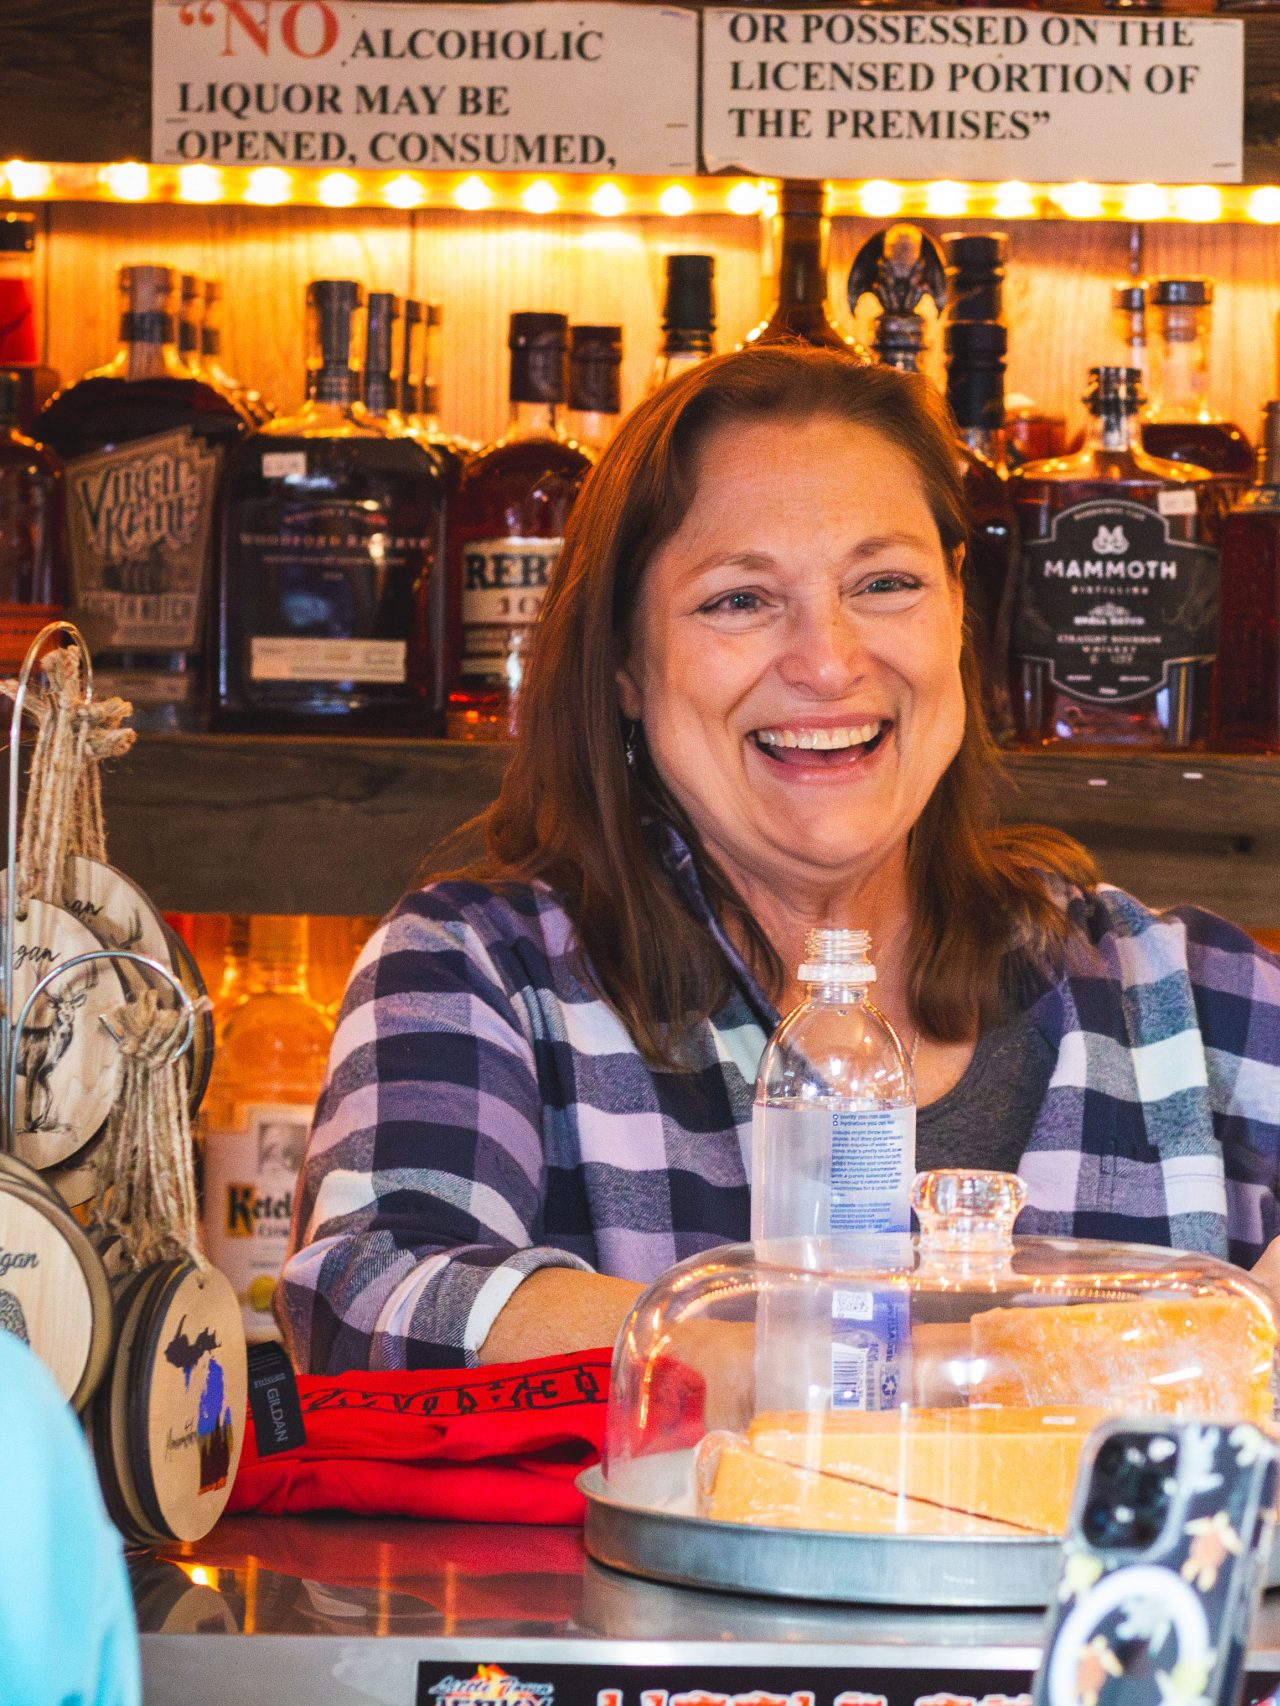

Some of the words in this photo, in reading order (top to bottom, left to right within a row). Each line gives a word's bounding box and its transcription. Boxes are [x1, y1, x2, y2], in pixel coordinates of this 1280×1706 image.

[350, 28, 603, 61] ALCOHOLIC
[728, 13, 788, 46] OR
[803, 14, 1028, 47] POSSESSED
[1042, 16, 1098, 46] ON
[1114, 20, 1195, 47] THE
[728, 61, 934, 92] LICENSED
[949, 63, 1131, 94] PORTION
[1145, 64, 1200, 95] OF
[178, 83, 342, 119] LIQUOR
[355, 85, 448, 117] MAY
[458, 86, 511, 117] BE
[728, 108, 811, 139] THE
[176, 131, 357, 166] OPENED,
[369, 132, 618, 170] CONSUMED,
[465, 553, 558, 591] REB
[1043, 559, 1178, 580] MAMMOTH
[265, 1387, 290, 1443] GILDAN
